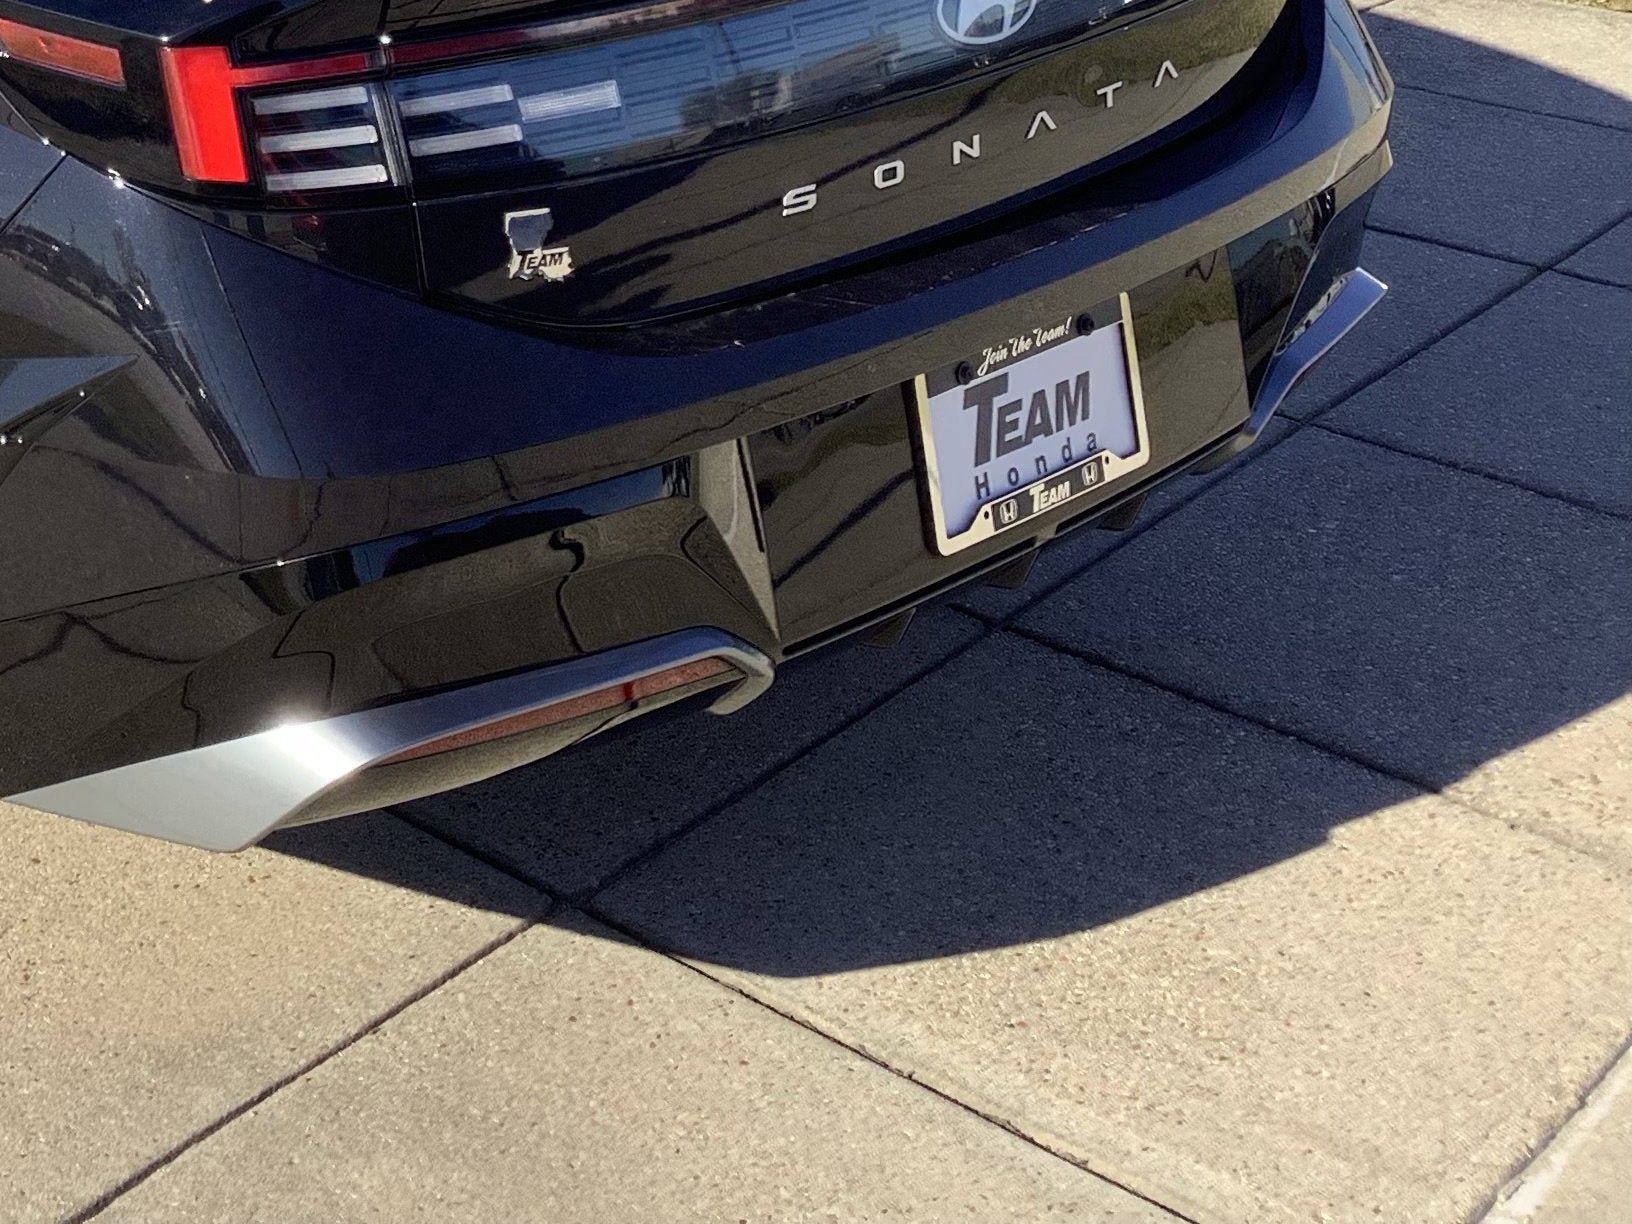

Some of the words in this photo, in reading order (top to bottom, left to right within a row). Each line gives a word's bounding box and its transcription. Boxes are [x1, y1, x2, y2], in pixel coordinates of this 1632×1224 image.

[782, 59, 1179, 217] SONATA
[517, 250, 563, 271] TEAM
[977, 344, 1008, 376] Join
[1008, 335, 1033, 358] The
[1033, 316, 1073, 347] Team!
[963, 371, 1090, 468] TEAM
[974, 432, 1097, 500] Honda
[1029, 481, 1070, 513] TEAM
